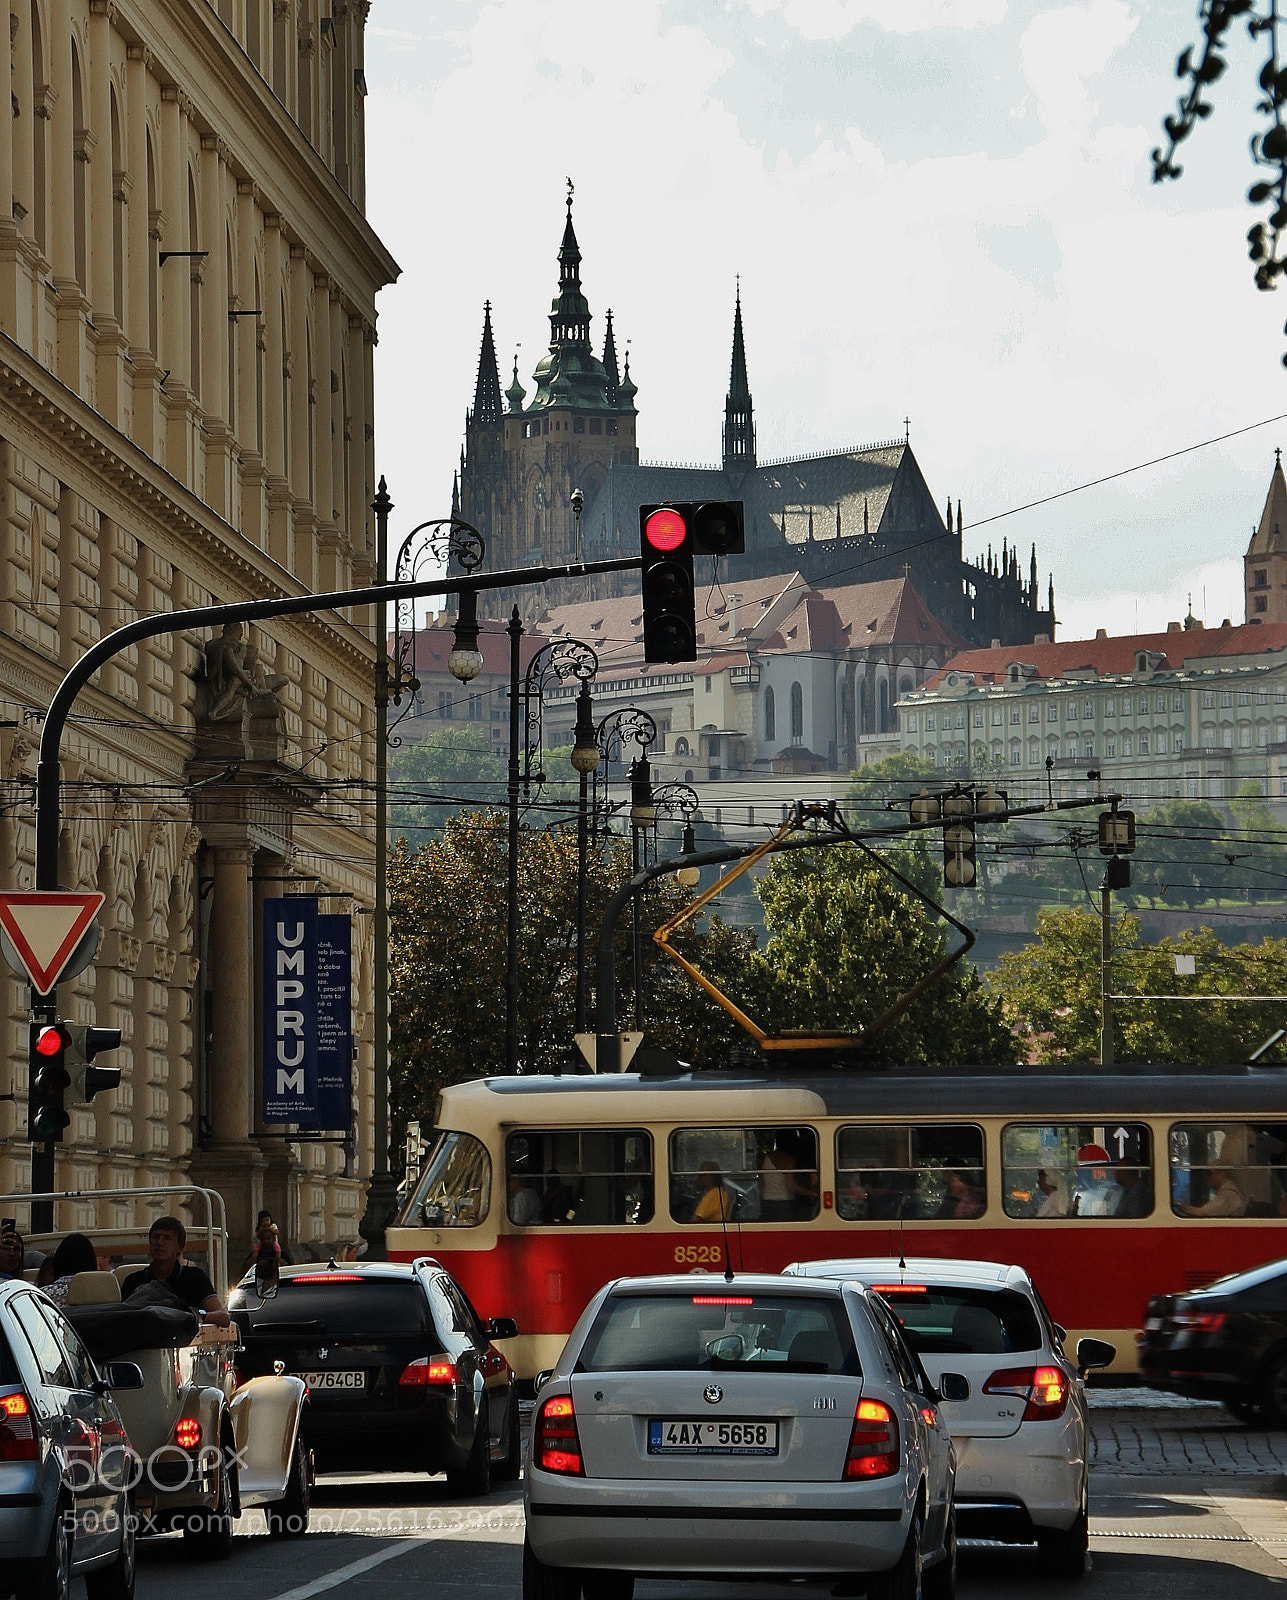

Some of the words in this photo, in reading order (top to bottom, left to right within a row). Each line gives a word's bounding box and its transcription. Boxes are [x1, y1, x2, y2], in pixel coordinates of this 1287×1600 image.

[276, 922, 305, 1094] UMPRUM
[673, 1245, 722, 1263] 8528
[316, 1372, 363, 1388] 764CB
[666, 1424, 703, 1445] 4AX
[718, 1424, 768, 1445] 5658
